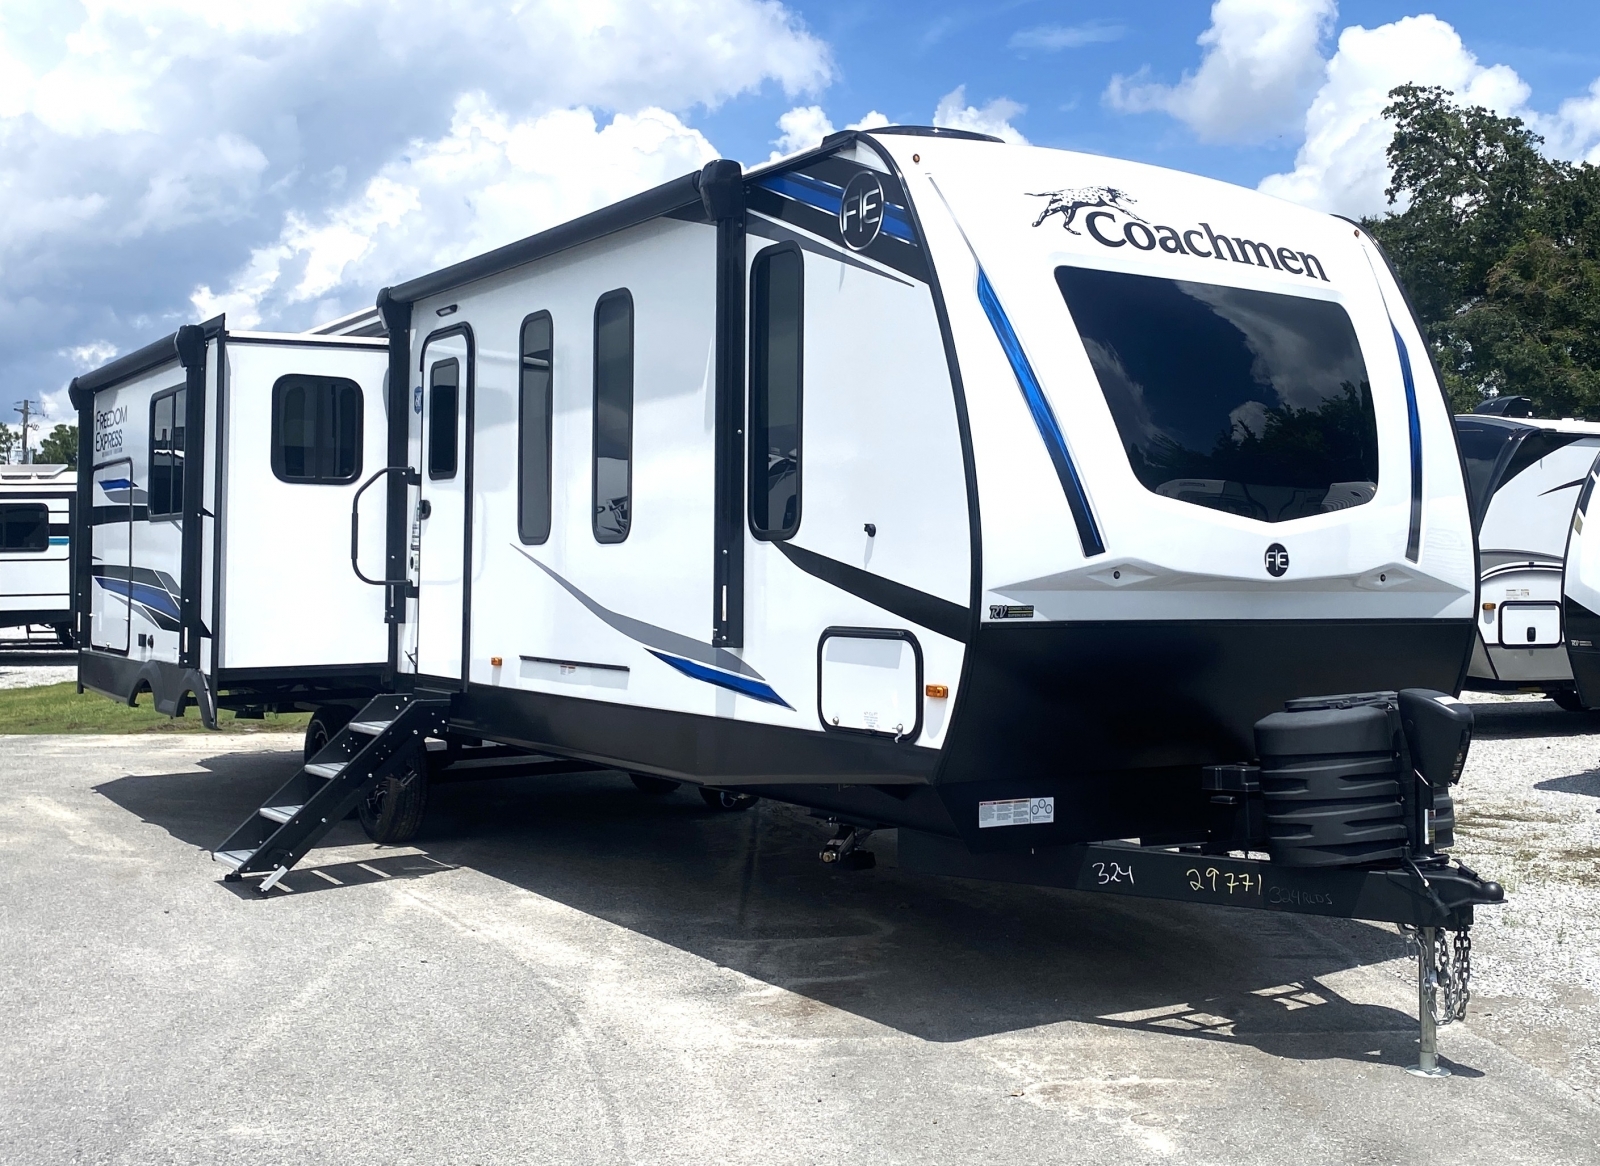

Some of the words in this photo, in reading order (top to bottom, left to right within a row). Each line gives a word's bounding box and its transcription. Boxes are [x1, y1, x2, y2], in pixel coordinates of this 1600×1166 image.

[1085, 211, 1331, 282] Coachmen
[96, 405, 127, 431] FREEDOM
[95, 429, 123, 452] EXPRESS
[989, 605, 1008, 619] RV
[1092, 862, 1135, 885] 324
[1186, 867, 1262, 896] 29771
